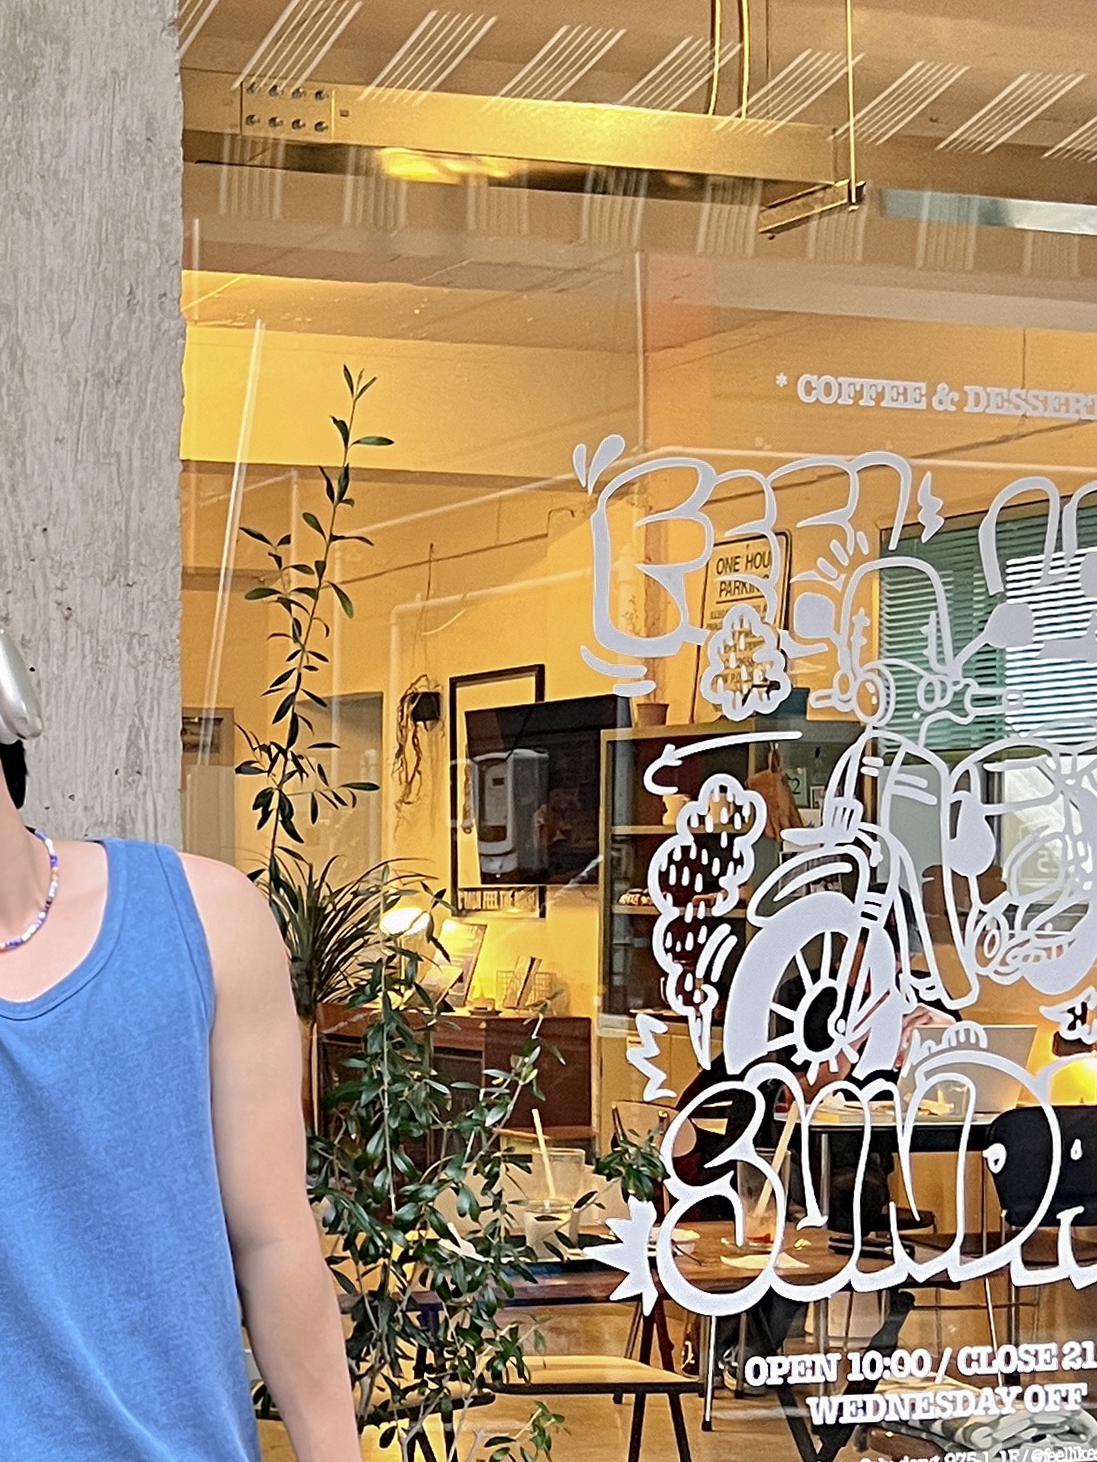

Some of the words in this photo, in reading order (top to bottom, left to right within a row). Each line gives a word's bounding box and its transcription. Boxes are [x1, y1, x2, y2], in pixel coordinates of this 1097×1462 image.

[797, 373, 927, 410] COFFEE
[932, 382, 959, 412] &
[716, 556, 741, 575] ONE
[745, 551, 771, 571] HOU
[719, 577, 767, 597] PARKIN
[744, 1353, 841, 1387] OPEN
[847, 1349, 933, 1381] 10:00
[934, 1347, 953, 1385] /
[957, 1342, 1058, 1376] CLOSE
[806, 1386, 1023, 1425] WEDNESDAY
[1024, 1382, 1088, 1413] OFF
